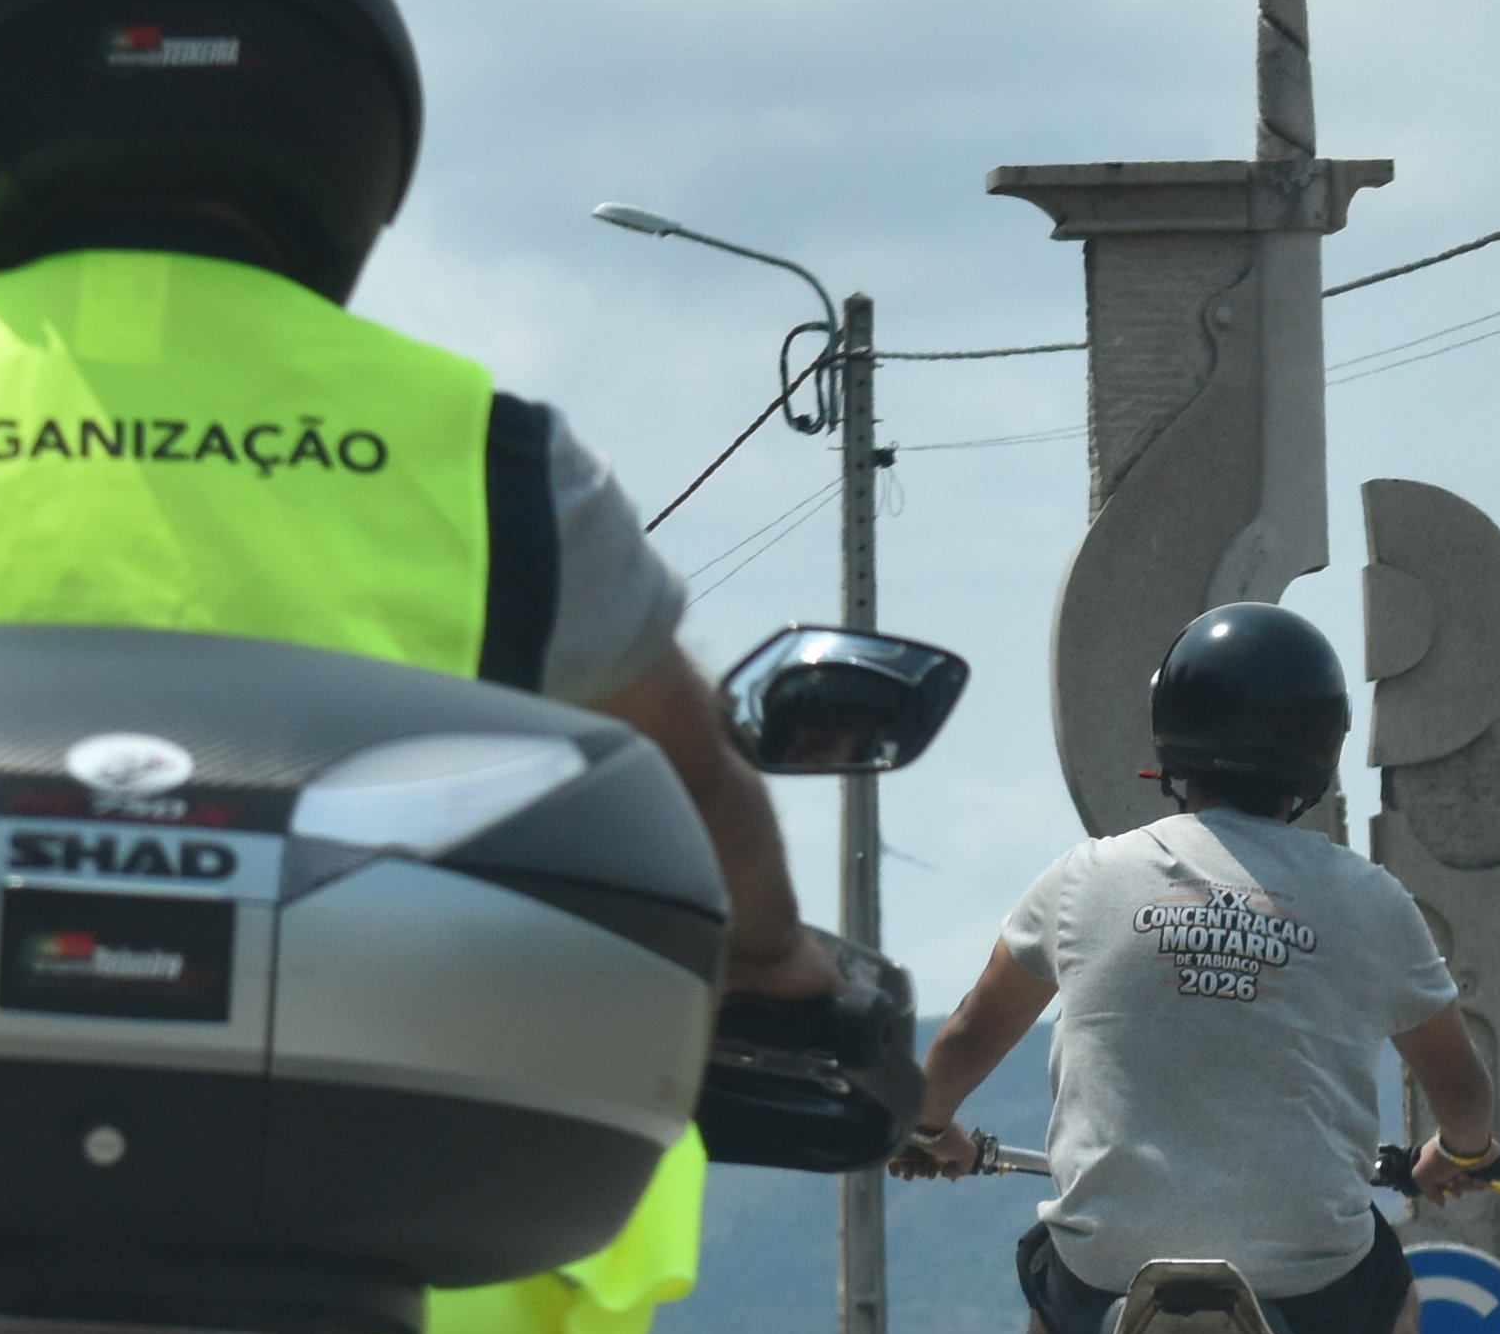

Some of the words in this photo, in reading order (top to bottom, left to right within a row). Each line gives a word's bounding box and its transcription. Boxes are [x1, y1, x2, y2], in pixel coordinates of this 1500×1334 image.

[9, 829, 239, 880] SHAD
[1205, 888, 1252, 911] XX
[1159, 925, 1289, 967] MOTARD
[1175, 953, 1193, 966] DE
[1178, 968, 1257, 1001] 2026
